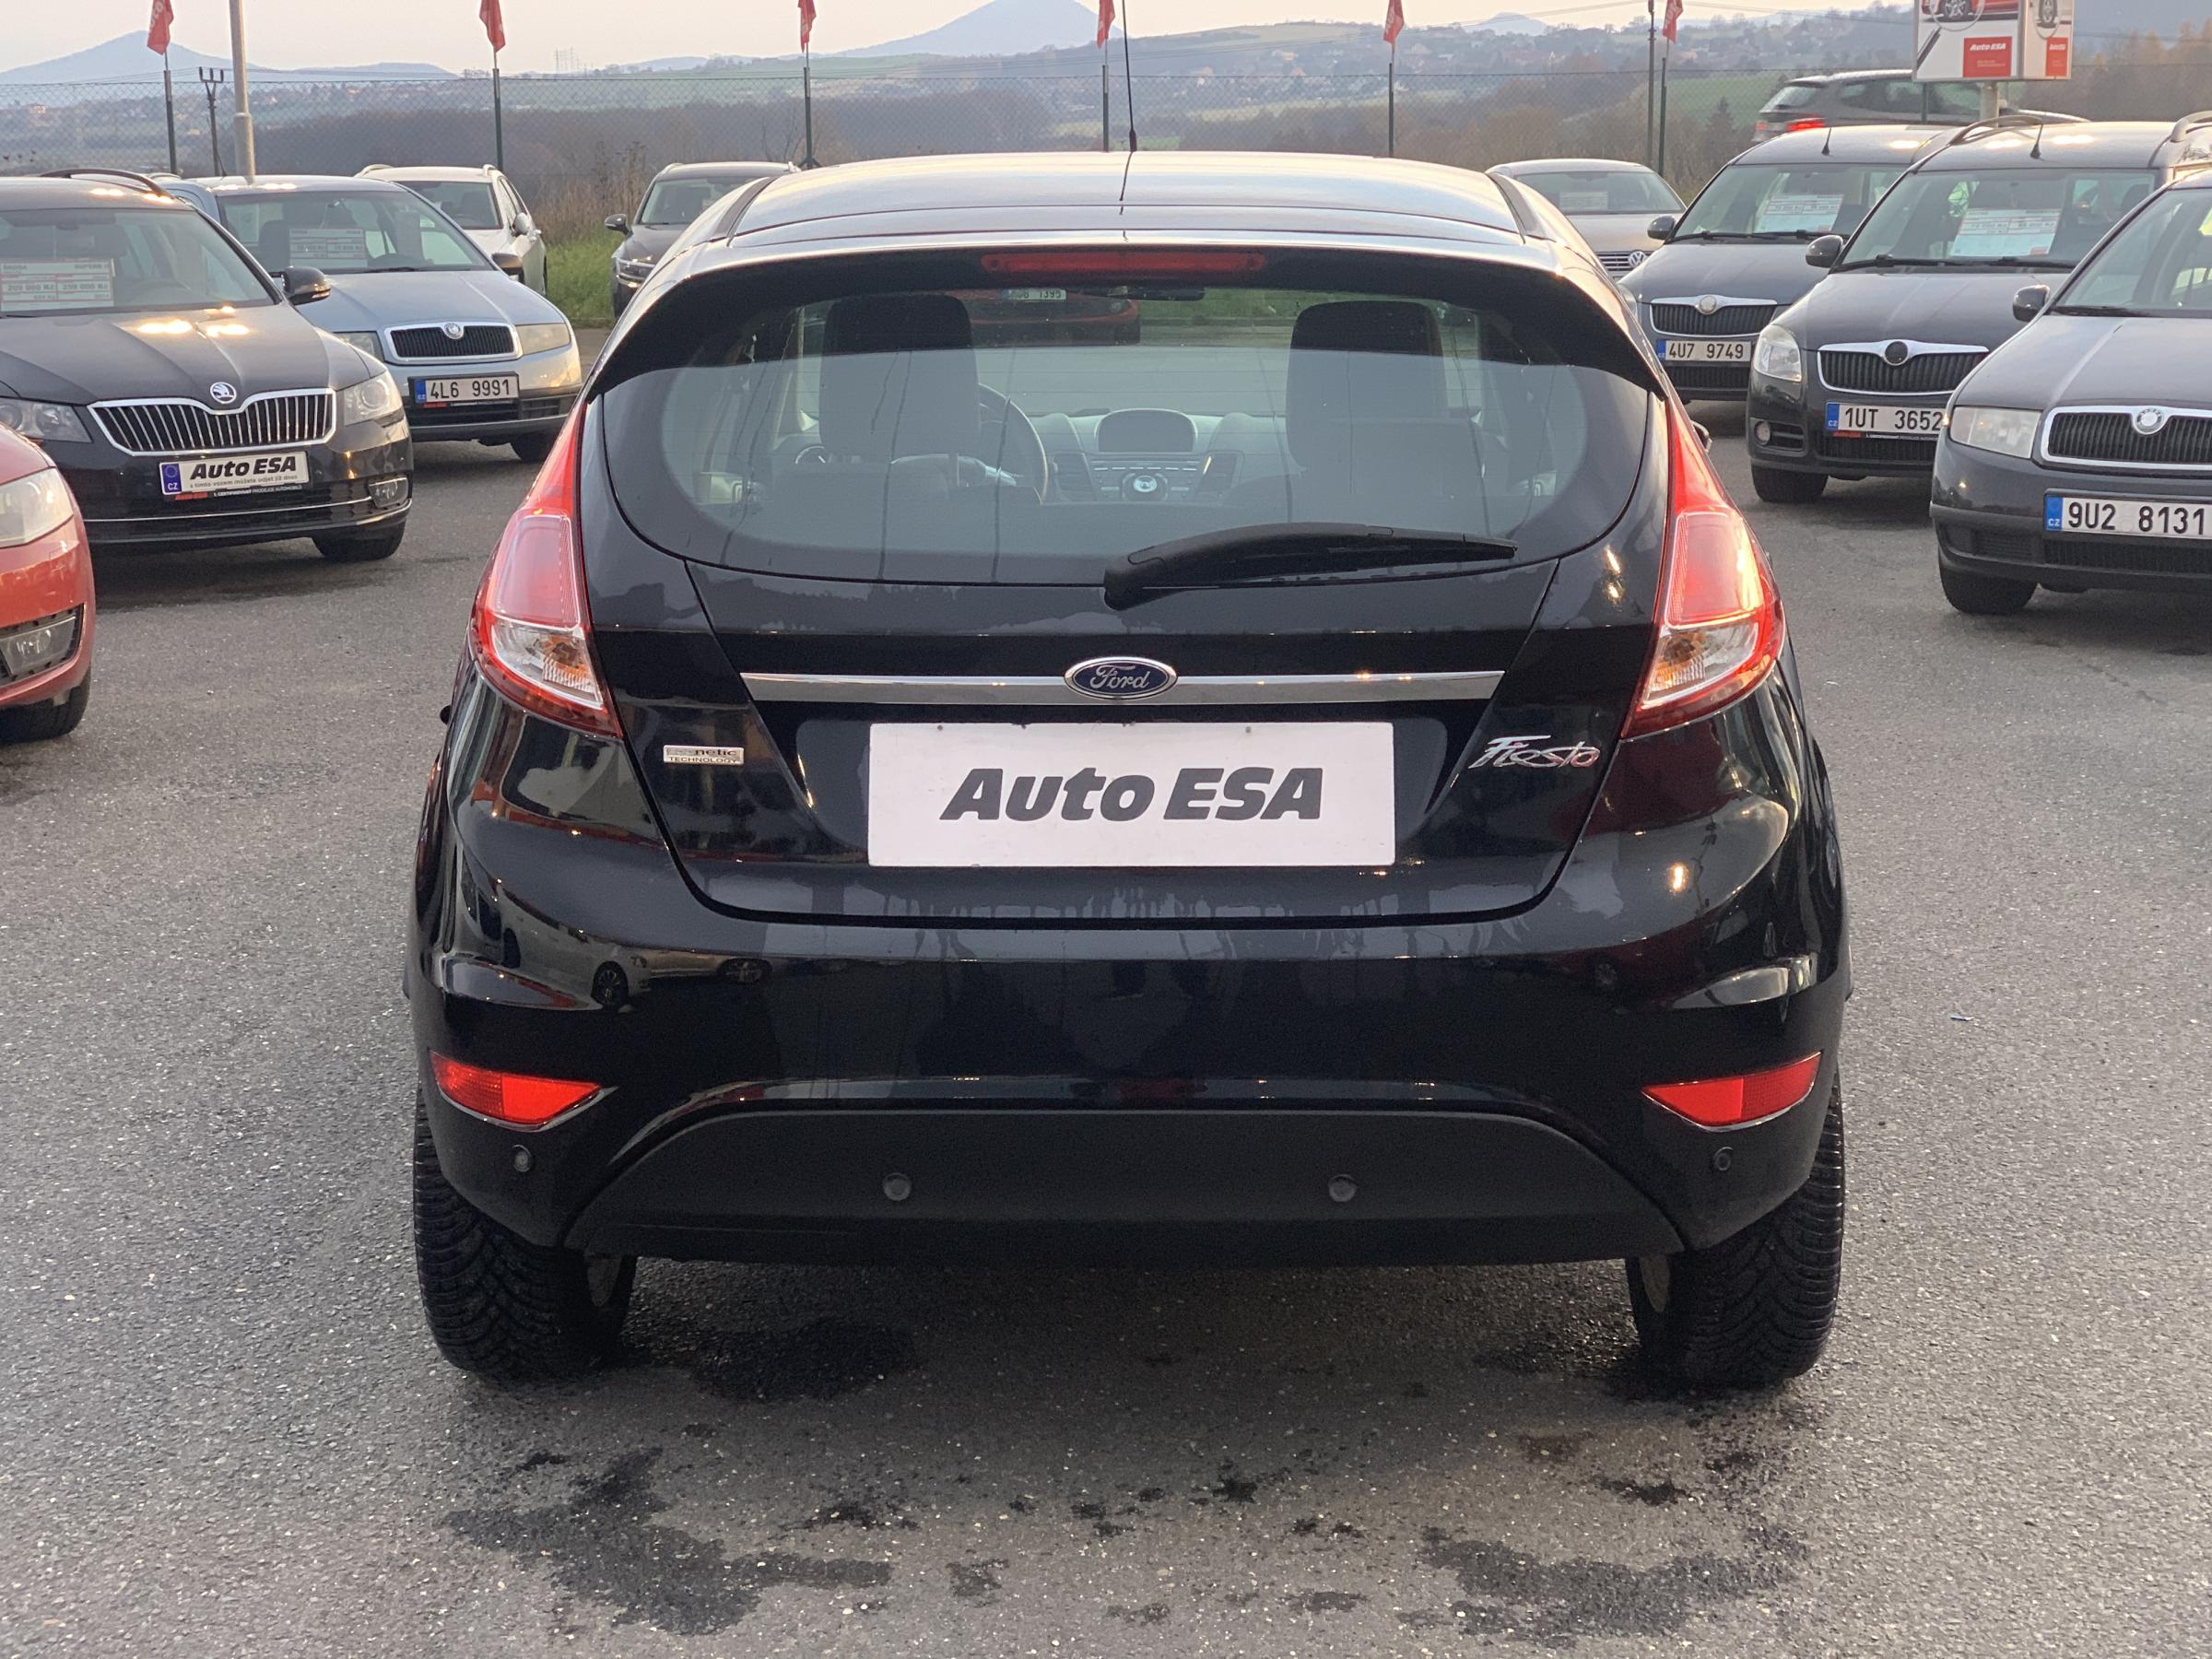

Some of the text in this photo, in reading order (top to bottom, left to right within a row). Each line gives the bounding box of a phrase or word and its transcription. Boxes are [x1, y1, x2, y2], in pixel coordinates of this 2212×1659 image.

[1991, 42, 2006, 51] ESA
[1669, 343, 1744, 359] 4U7 9749
[430, 379, 510, 399] 4L6 9991
[1845, 407, 1943, 430] 1UT 3652
[190, 455, 296, 480] Auto ESA
[167, 482, 179, 490] CZ
[2048, 518, 2060, 526] CZ
[2068, 501, 2205, 535] 9U2 8131
[1089, 665, 1151, 689] Ford
[669, 756, 737, 764] TECHNOLOGY
[939, 767, 1324, 821] Auto ESA
